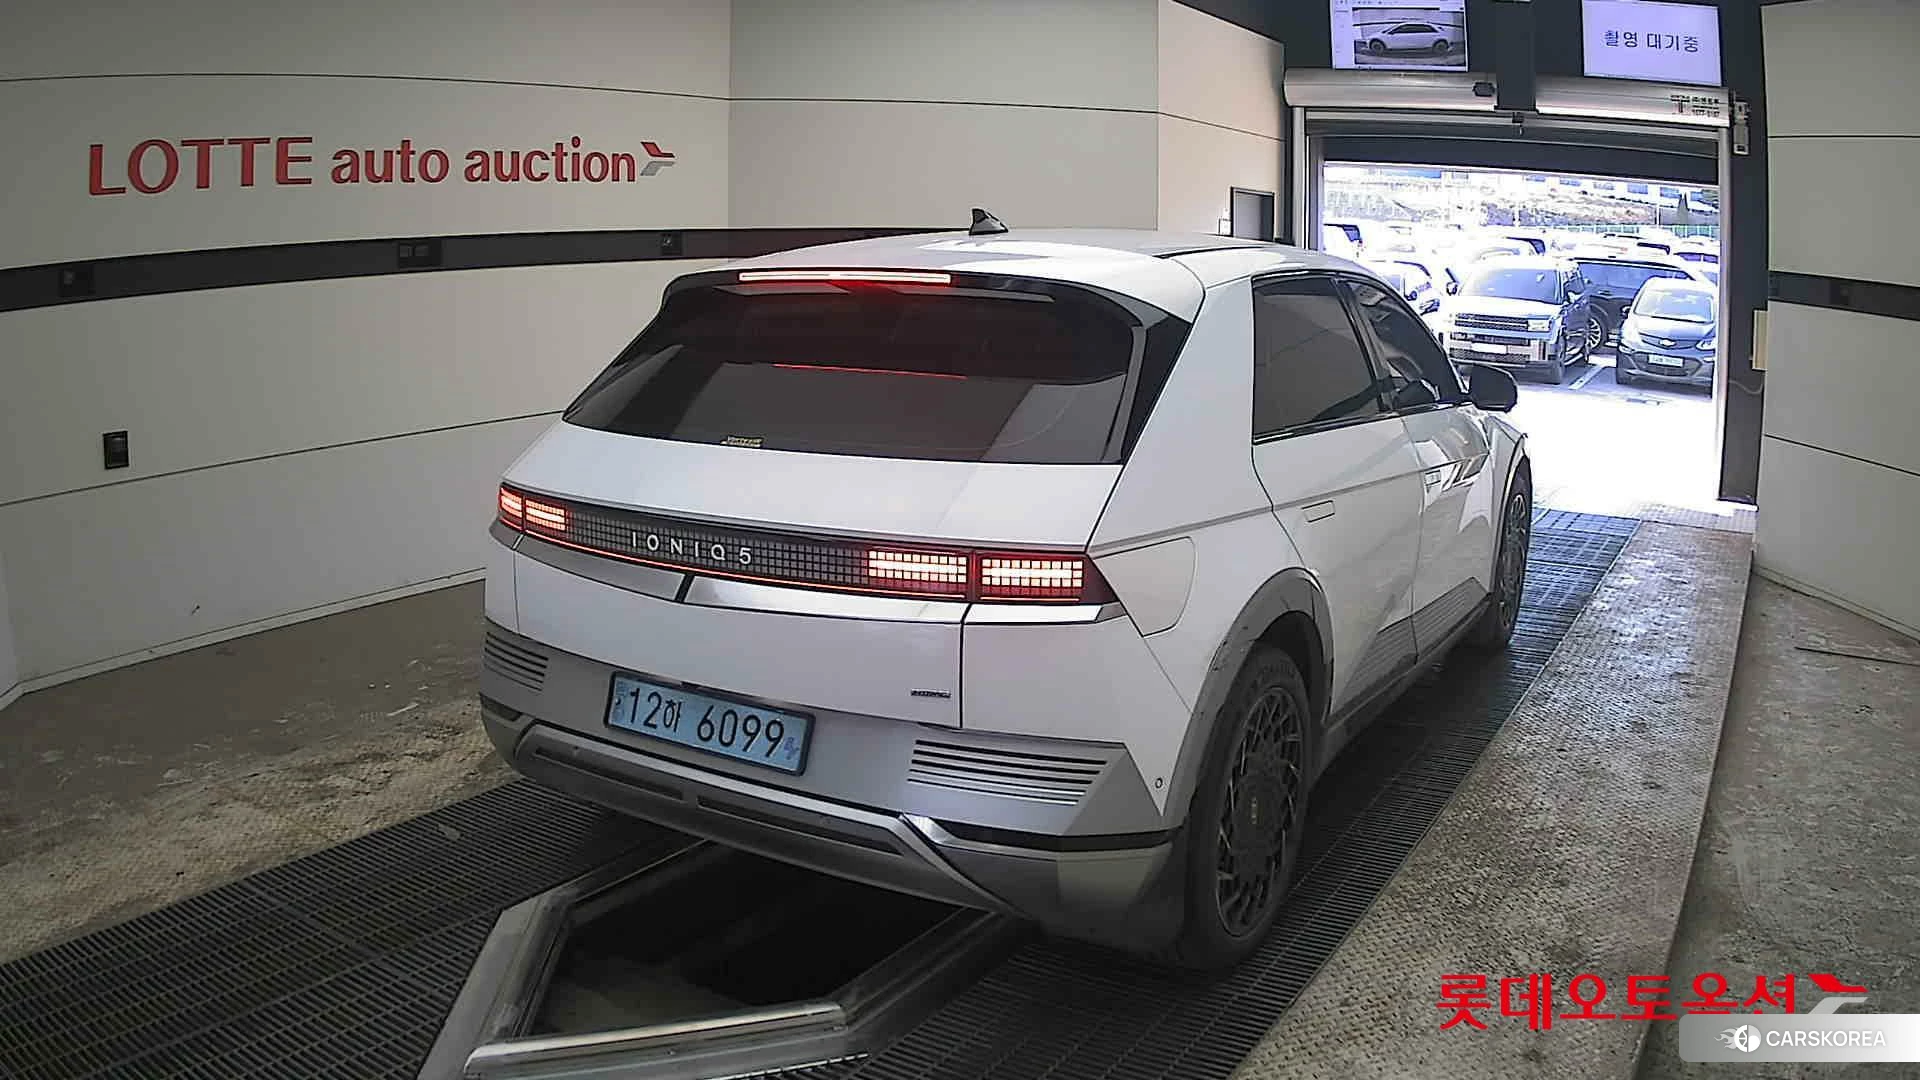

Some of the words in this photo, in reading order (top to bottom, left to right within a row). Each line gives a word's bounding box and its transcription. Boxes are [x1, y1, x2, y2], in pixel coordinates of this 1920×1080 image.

[1646, 33, 1698, 52] 대기중
[89, 136, 313, 196] LOTTE
[331, 138, 450, 184] auto
[464, 136, 637, 184] auction
[632, 531, 726, 561] IONIQ
[739, 547, 752, 565] 5
[629, 687, 684, 733] 12하
[697, 705, 785, 758] 6099
